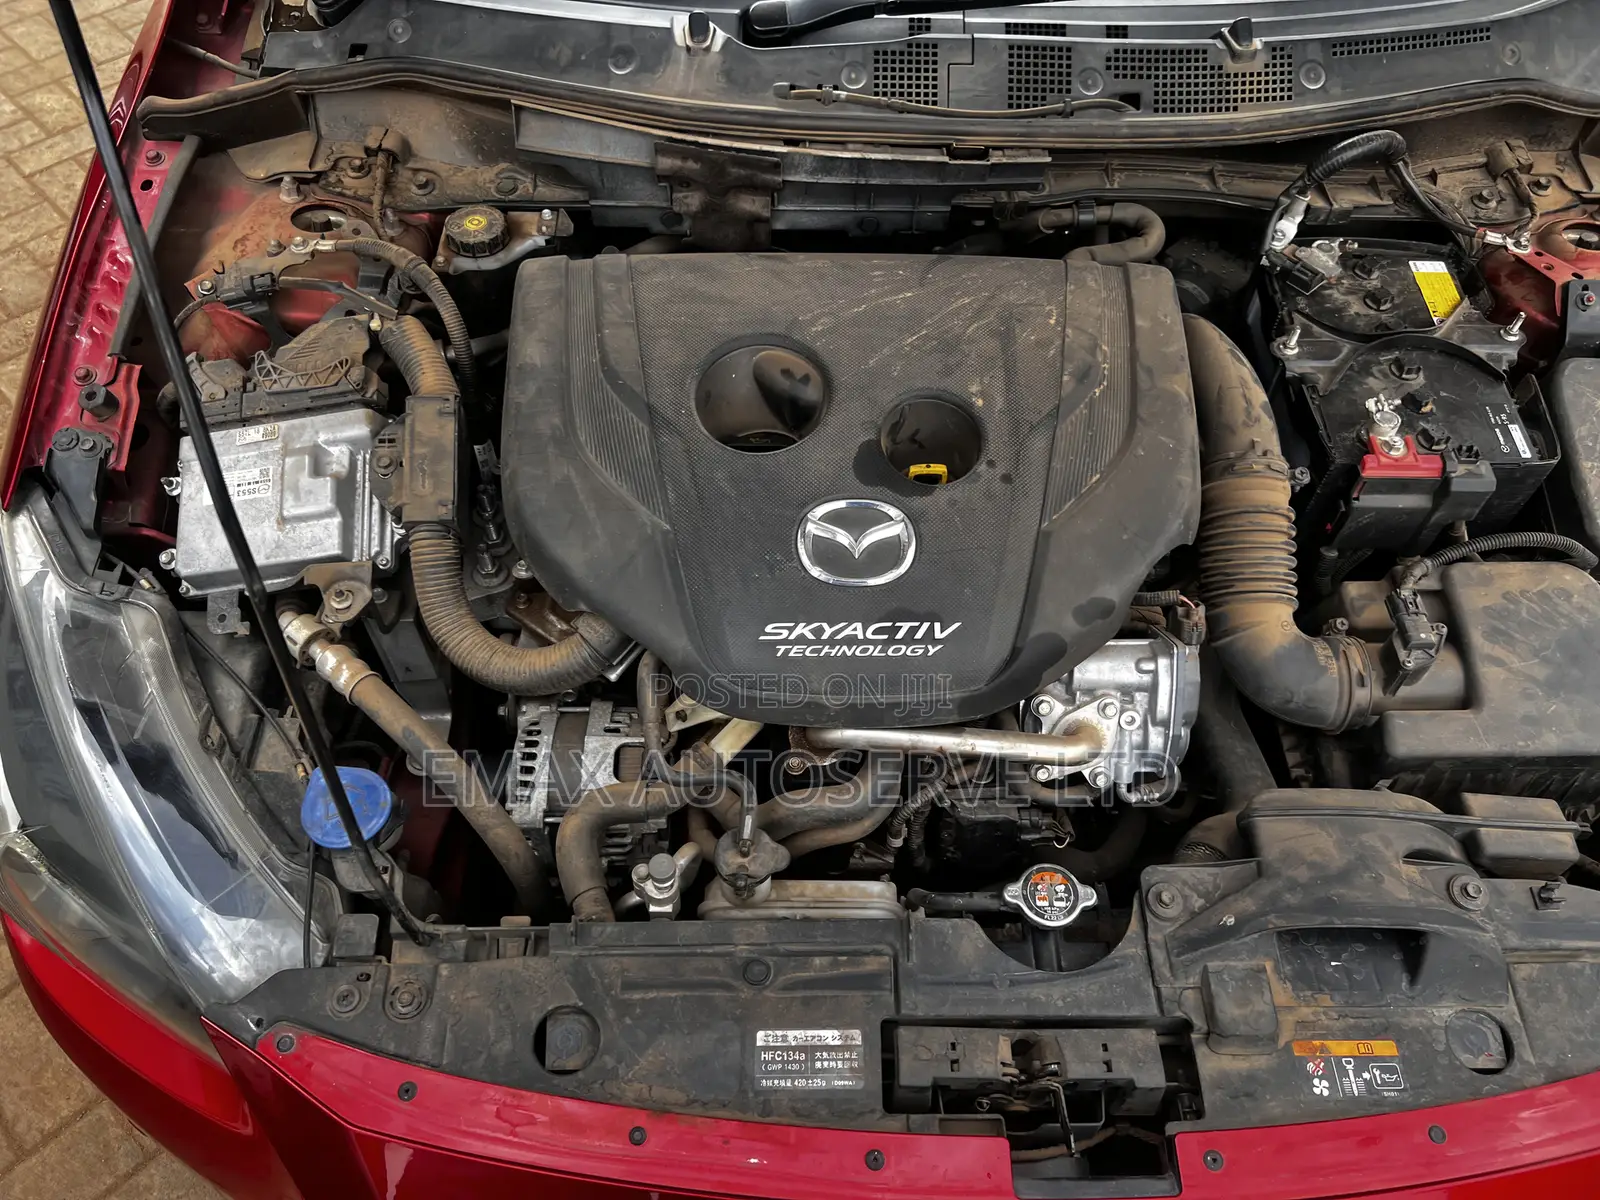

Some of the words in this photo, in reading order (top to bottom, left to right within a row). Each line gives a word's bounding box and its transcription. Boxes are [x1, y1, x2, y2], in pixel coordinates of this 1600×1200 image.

[236, 487, 257, 497] S553
[758, 622, 963, 640] SKYACTIV
[776, 645, 944, 657] TECHNOLOGY
[760, 1051, 806, 1061] HFC134a
